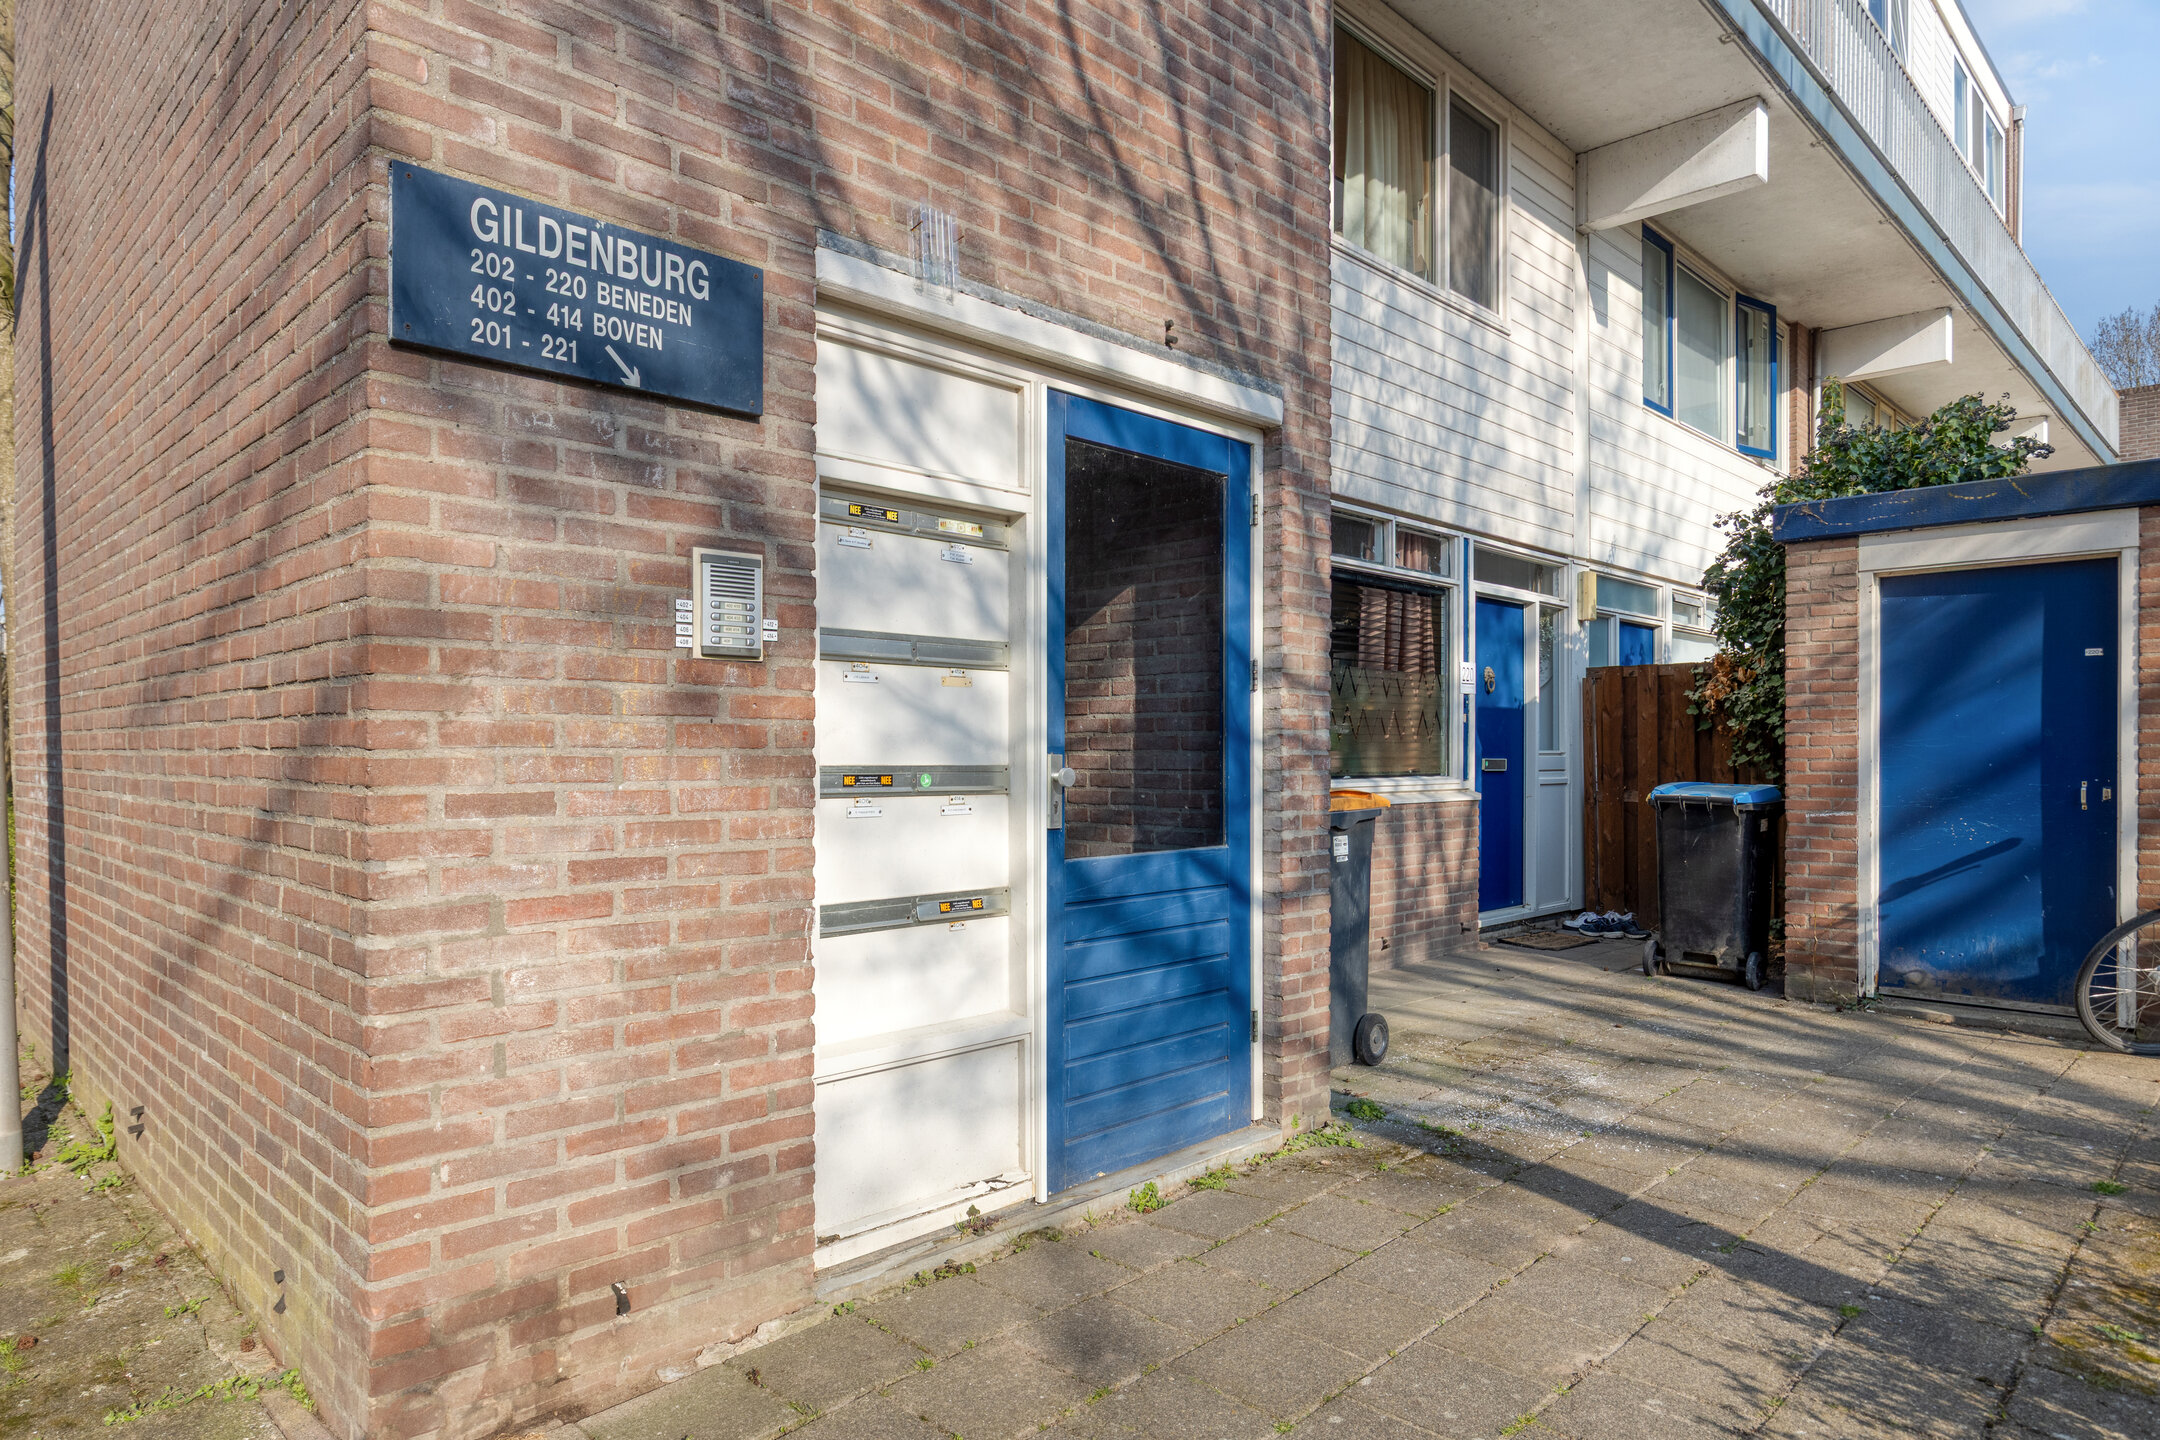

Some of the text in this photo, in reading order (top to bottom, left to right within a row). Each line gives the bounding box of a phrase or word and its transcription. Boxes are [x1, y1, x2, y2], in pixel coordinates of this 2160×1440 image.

[470, 197, 710, 301] GILDENBURG
[470, 248, 515, 283] 202
[545, 267, 587, 300] 220
[597, 281, 692, 327] BENEDEN
[470, 284, 517, 317] 402
[546, 302, 584, 332] 414
[593, 313, 663, 351] BOVEN
[470, 317, 512, 350] 201
[541, 333, 578, 363] 221
[850, 505, 861, 514] NEE
[886, 511, 898, 521] NEE
[1462, 667, 1474, 682] 220
[843, 775, 855, 786] NEE
[881, 775, 892, 785] NEE
[940, 902, 950, 912] NEE
[972, 899, 983, 909] NEE
